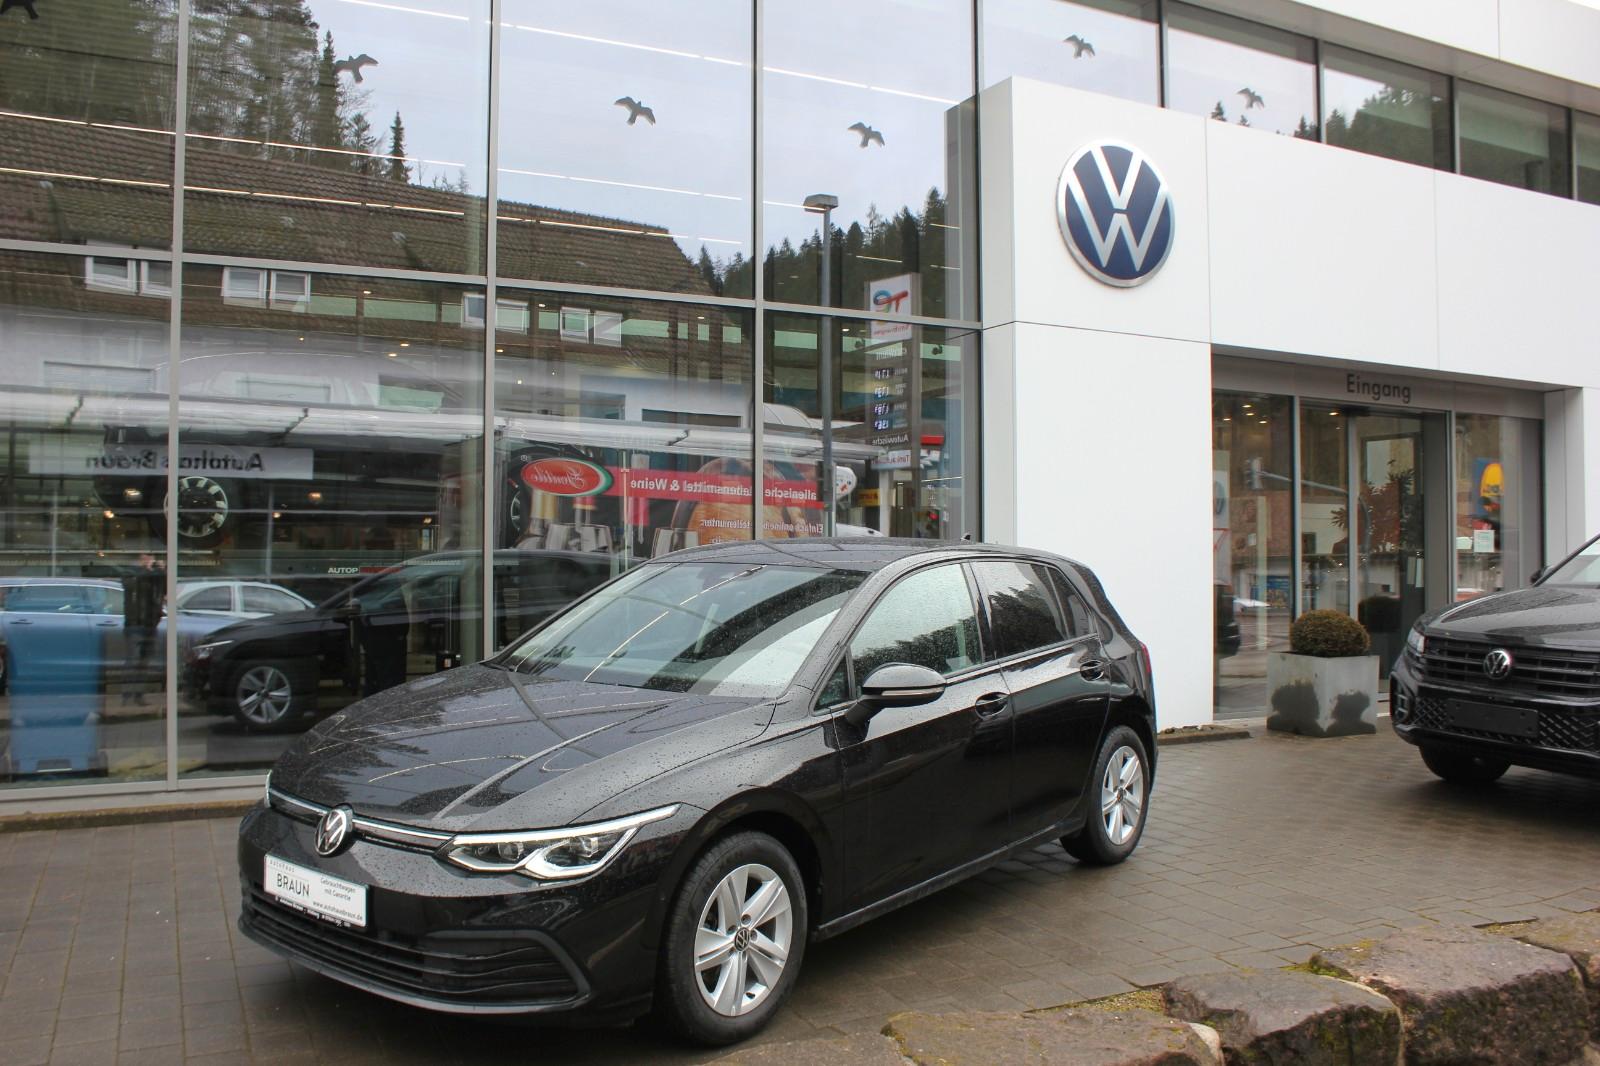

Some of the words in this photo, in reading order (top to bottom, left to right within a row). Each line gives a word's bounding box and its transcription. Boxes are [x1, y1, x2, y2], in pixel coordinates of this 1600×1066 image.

[1346, 373, 1411, 404] Eingang
[276, 873, 310, 898] BRAUN
[324, 888, 333, 897] mit
[333, 889, 352, 901] Garantie
